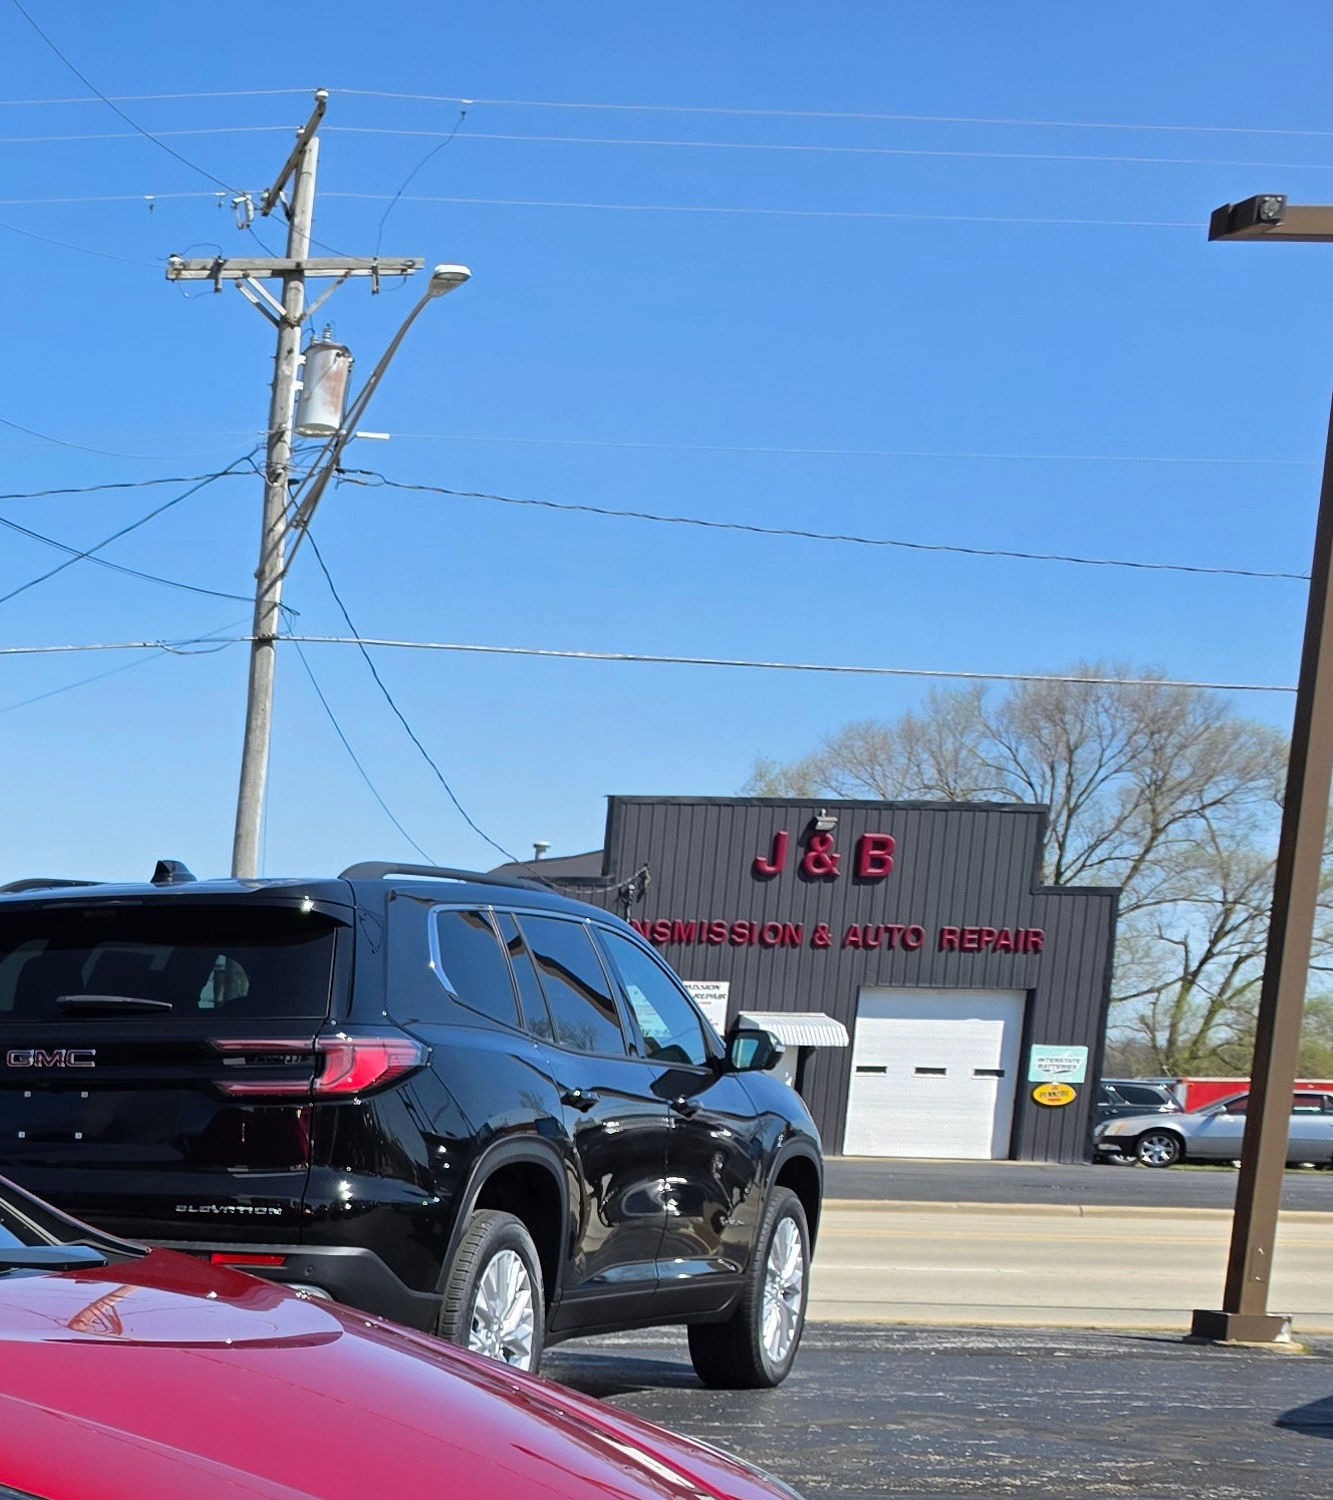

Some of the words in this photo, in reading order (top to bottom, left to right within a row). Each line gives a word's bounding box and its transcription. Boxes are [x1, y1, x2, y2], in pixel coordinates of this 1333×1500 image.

[755, 831, 789, 875] J
[803, 832, 841, 874] &
[858, 833, 896, 876] B
[813, 922, 832, 947] &
[844, 923, 925, 948] AUTO
[940, 926, 1044, 950] REPAIR
[6, 1049, 96, 1068] GMC
[175, 1204, 283, 1215] ELEVATION
